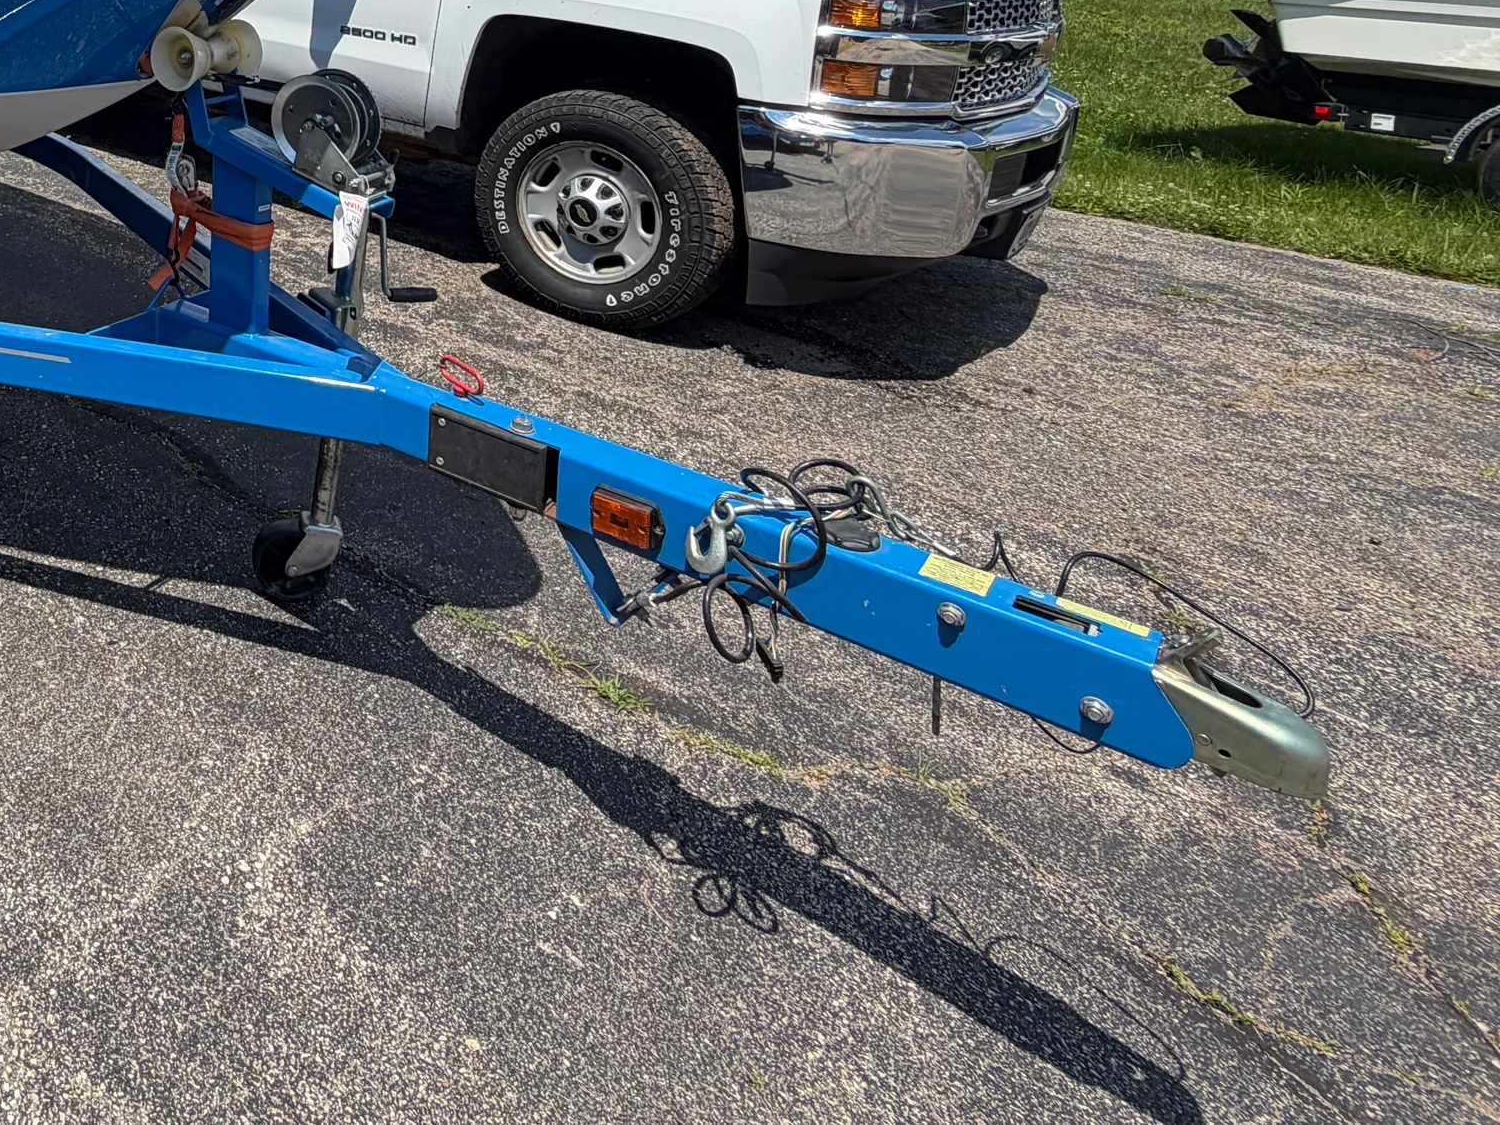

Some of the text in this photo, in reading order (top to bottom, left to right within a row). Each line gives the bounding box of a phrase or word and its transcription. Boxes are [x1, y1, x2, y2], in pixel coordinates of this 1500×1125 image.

[340, 25, 417, 46] 2500 HD
[493, 126, 549, 235] DESTINATION
